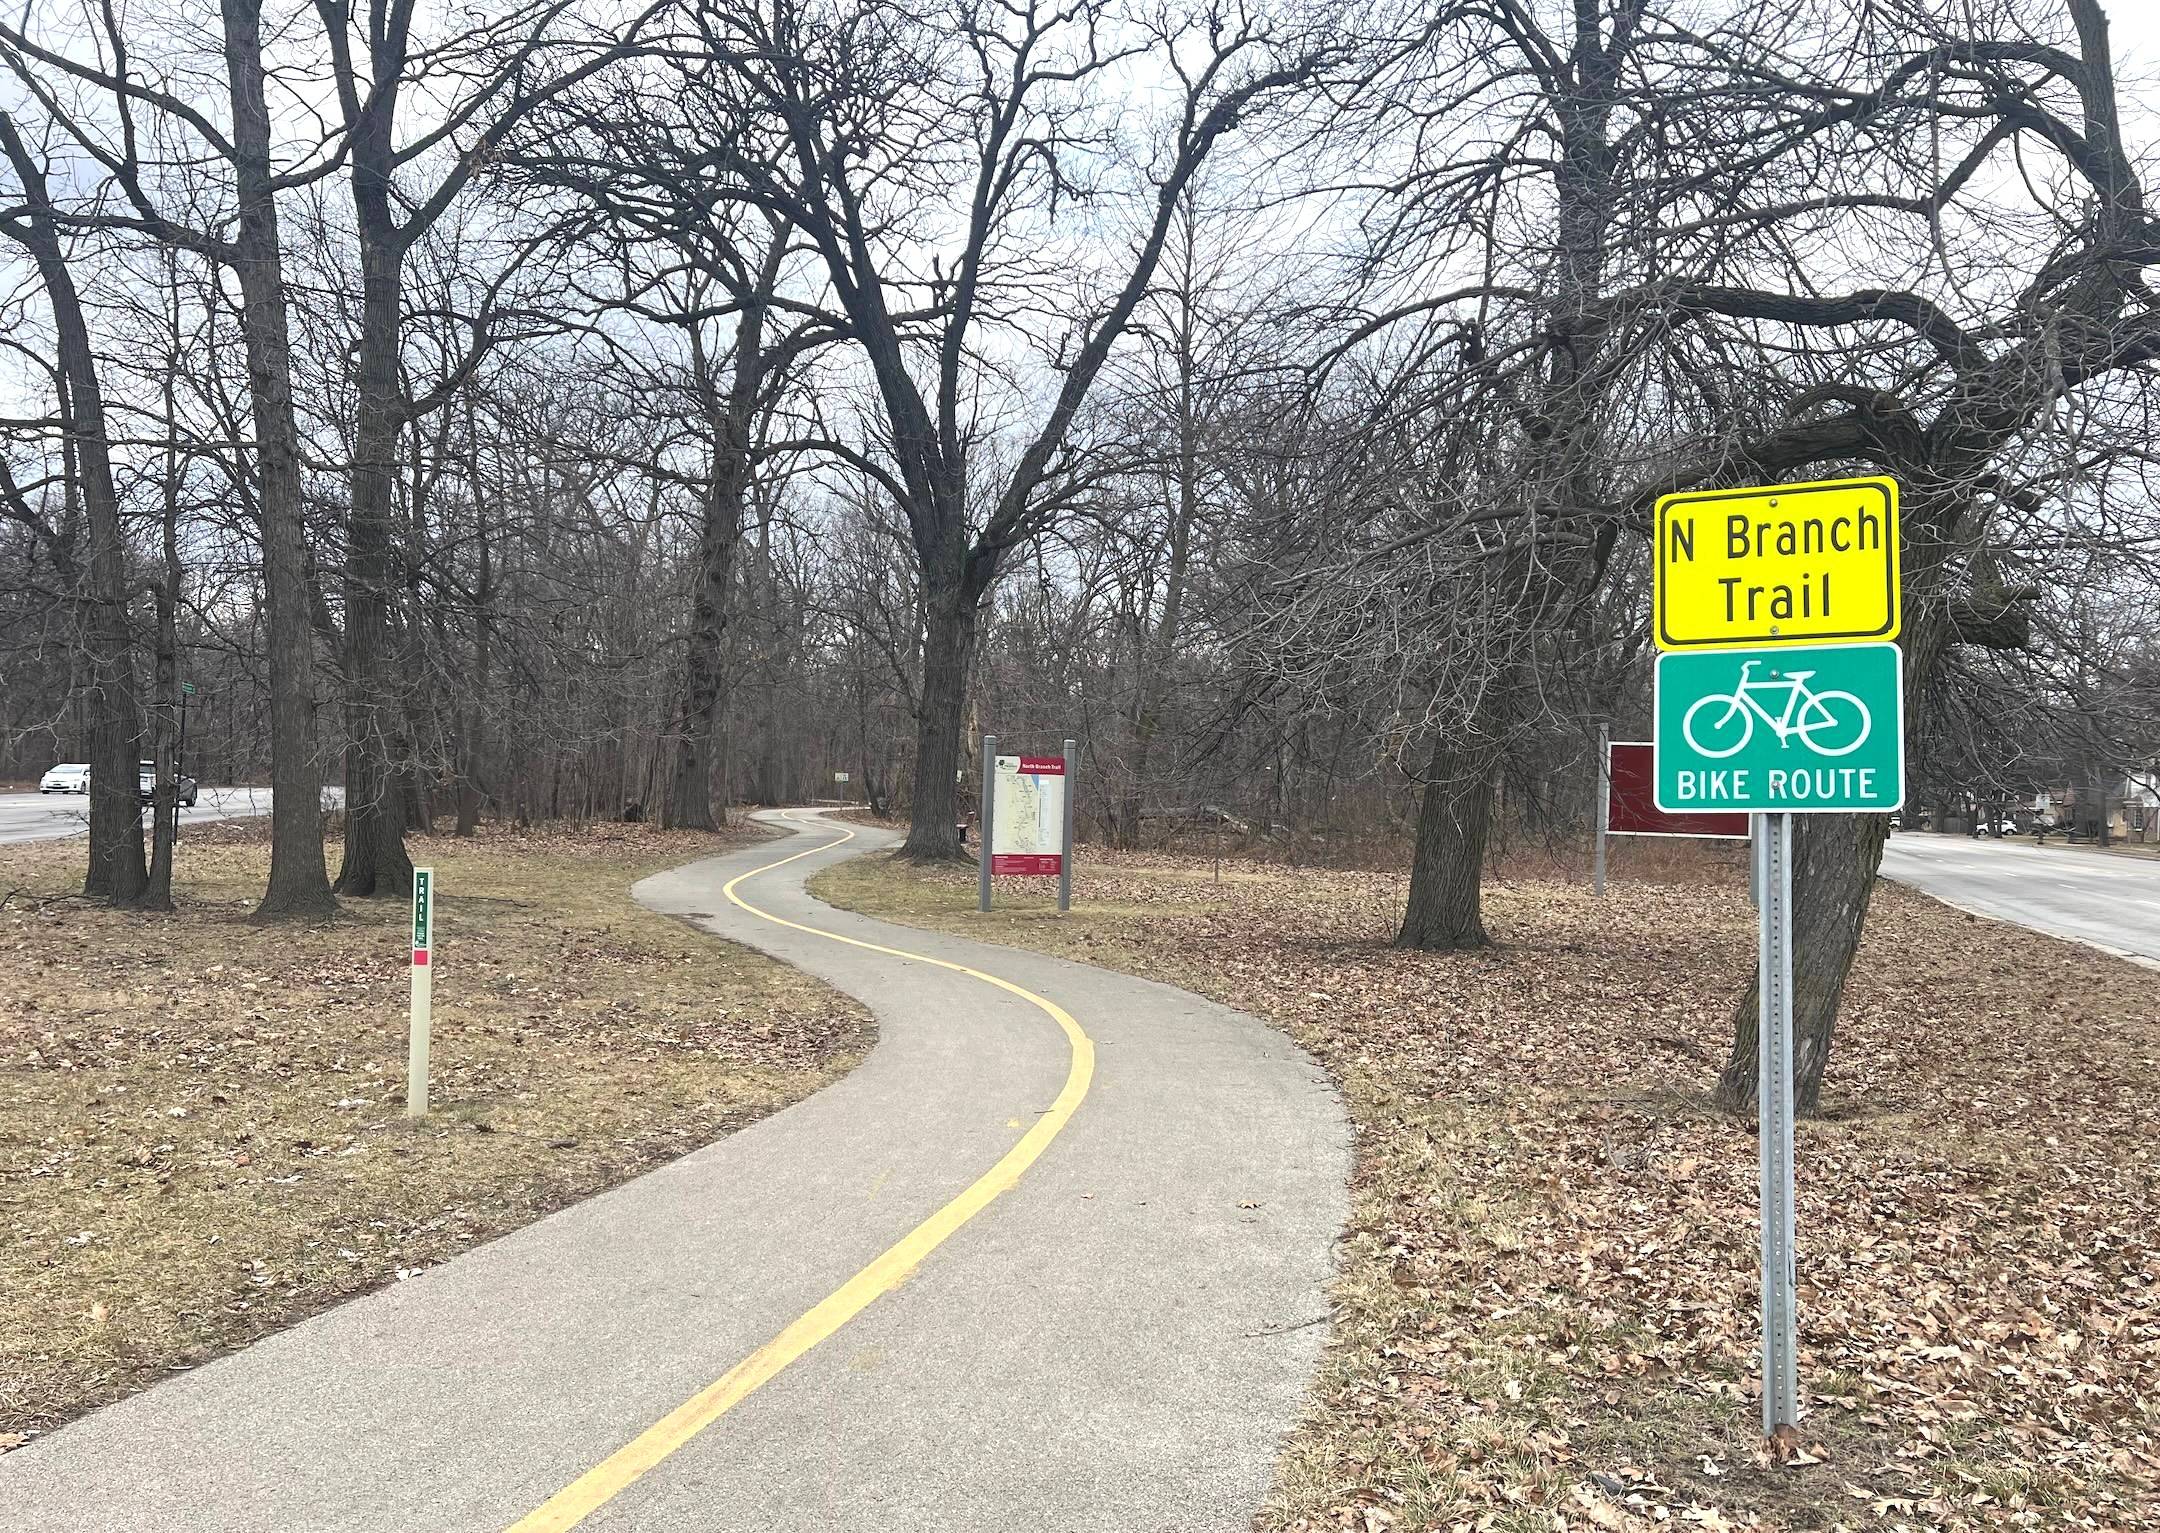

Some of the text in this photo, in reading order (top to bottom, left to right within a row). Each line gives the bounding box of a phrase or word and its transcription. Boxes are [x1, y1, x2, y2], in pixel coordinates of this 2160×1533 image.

[1671, 506, 1879, 562] N Branch
[1718, 572, 1830, 622] Trail
[1677, 768, 1878, 799] BIKE ROUTE
